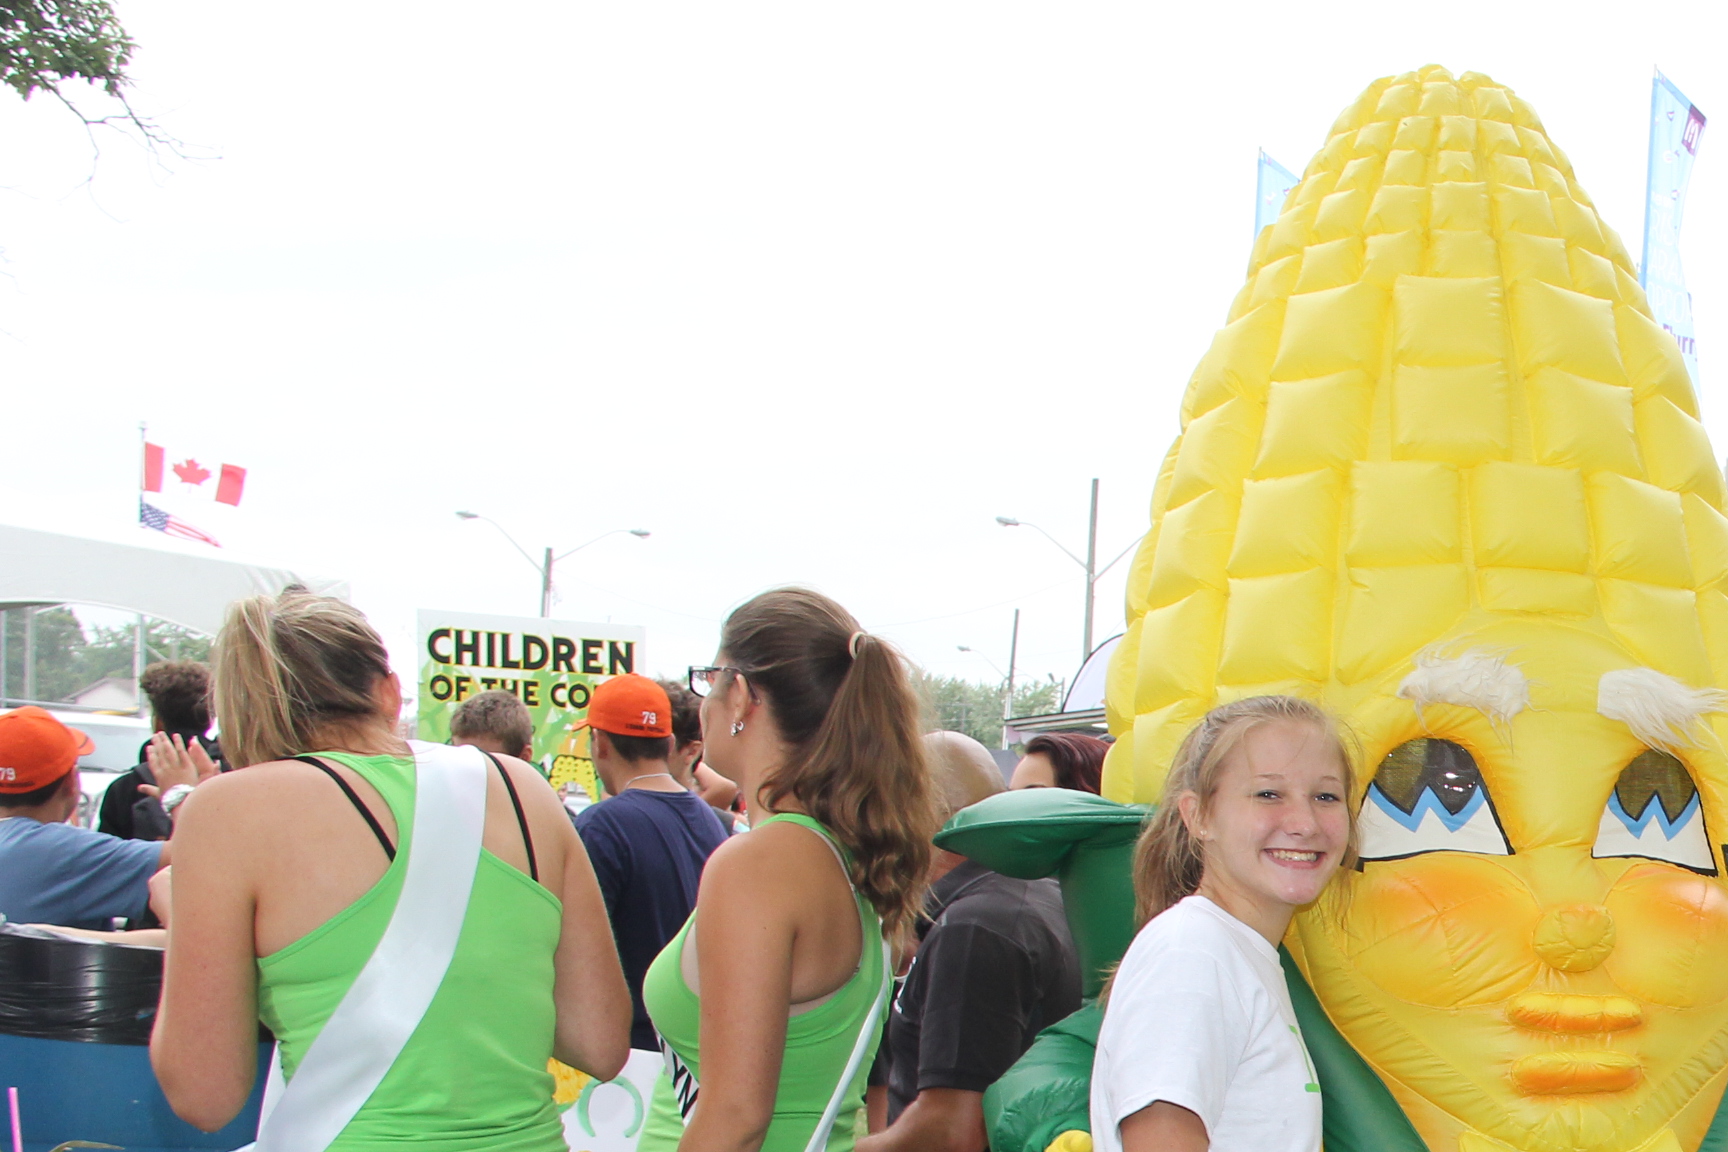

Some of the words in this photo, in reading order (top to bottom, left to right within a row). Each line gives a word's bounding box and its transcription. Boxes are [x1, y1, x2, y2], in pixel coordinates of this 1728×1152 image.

[427, 627, 636, 676] CHILDREN
[430, 675, 472, 702] OF
[550, 682, 600, 709] CO
[642, 710, 657, 725] 79
